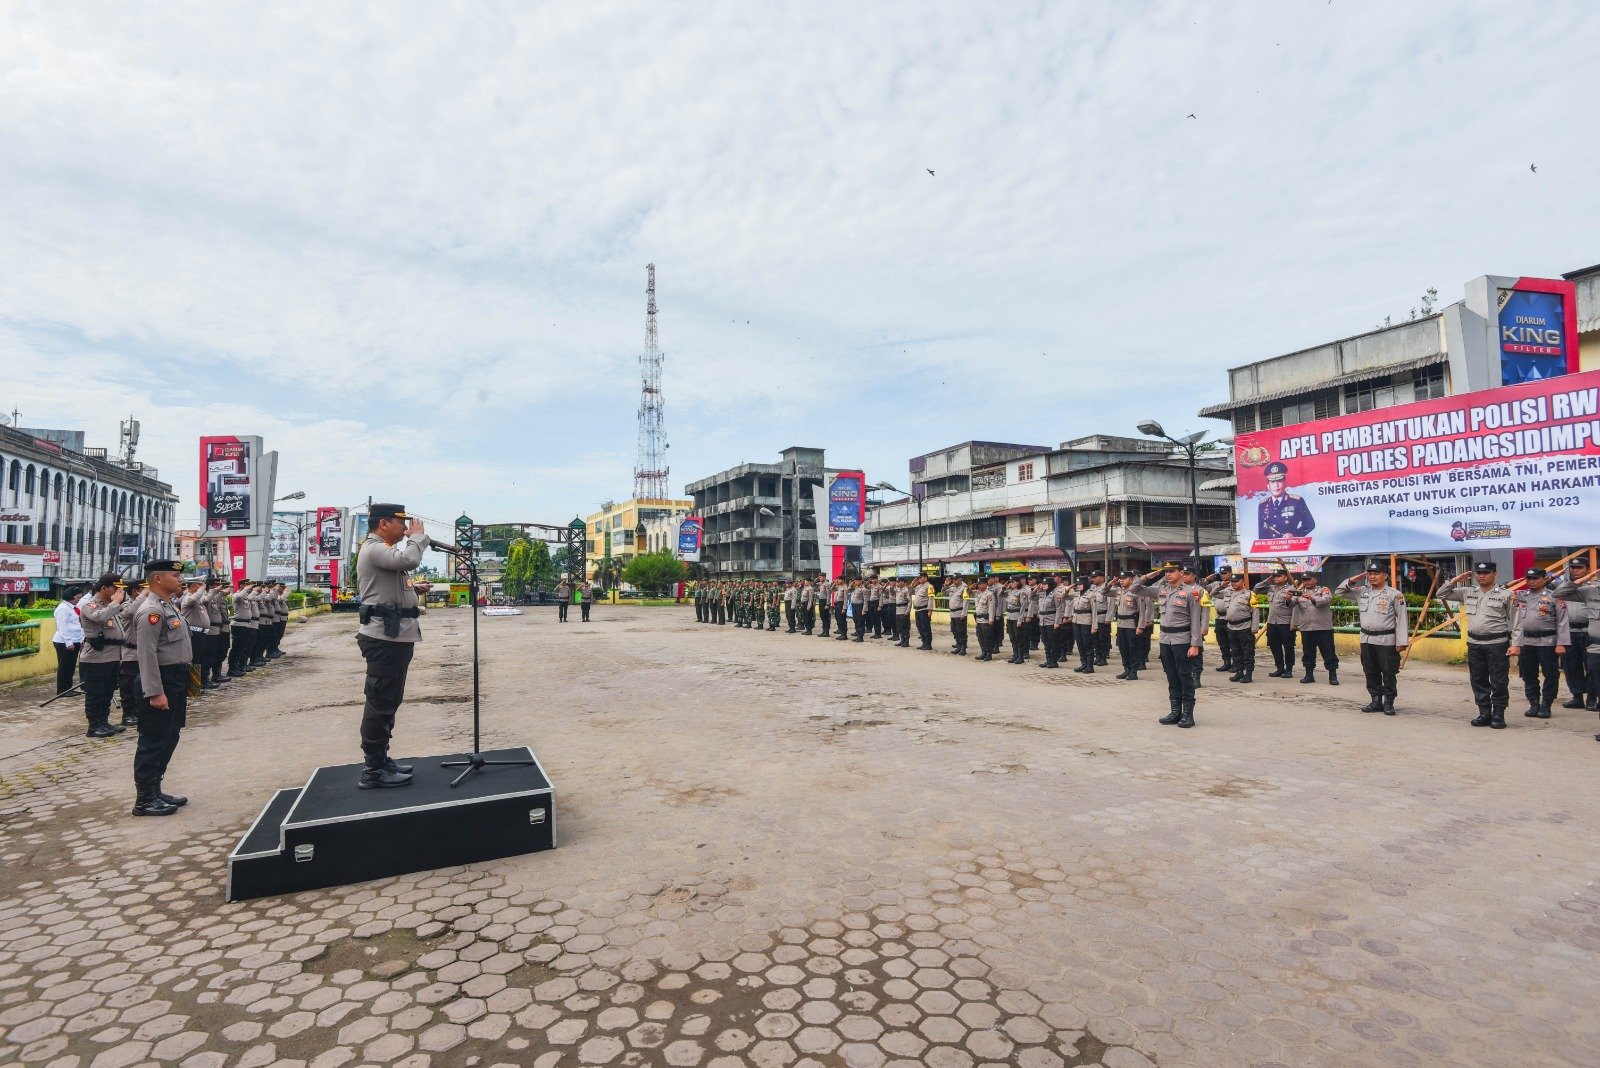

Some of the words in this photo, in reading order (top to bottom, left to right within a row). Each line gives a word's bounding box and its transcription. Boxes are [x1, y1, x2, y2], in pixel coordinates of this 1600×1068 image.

[1497, 289, 1508, 307] NEW
[1515, 315, 1546, 325] DJARUM
[1502, 325, 1561, 345] KING
[1513, 345, 1552, 354] FILTER
[1280, 434, 1319, 460] APEL
[1321, 410, 1466, 453] PEMBENTUKAN
[1470, 396, 1547, 431] POLISI
[1552, 388, 1598, 420] RW
[1337, 446, 1408, 477] POLRES
[1318, 480, 1380, 496] SINERGITAS
[1382, 476, 1419, 489] POLISI
[1423, 474, 1442, 485] RW
[1448, 467, 1511, 482] BERSAMA
[1515, 463, 1543, 476] TNI,
[831, 490, 858, 498] KING
[1337, 492, 1410, 508] MASYARAKAT
[1414, 489, 1457, 501] UNTUK
[1460, 482, 1527, 498] CIPTAKAN
[214, 501, 243, 513] SUPER
[1389, 509, 1429, 518] Padang
[1432, 504, 1498, 515] Sidimpuan,
[1502, 501, 1516, 510] 07
[1519, 499, 1544, 511] juni
[1548, 496, 1580, 507] 2023
